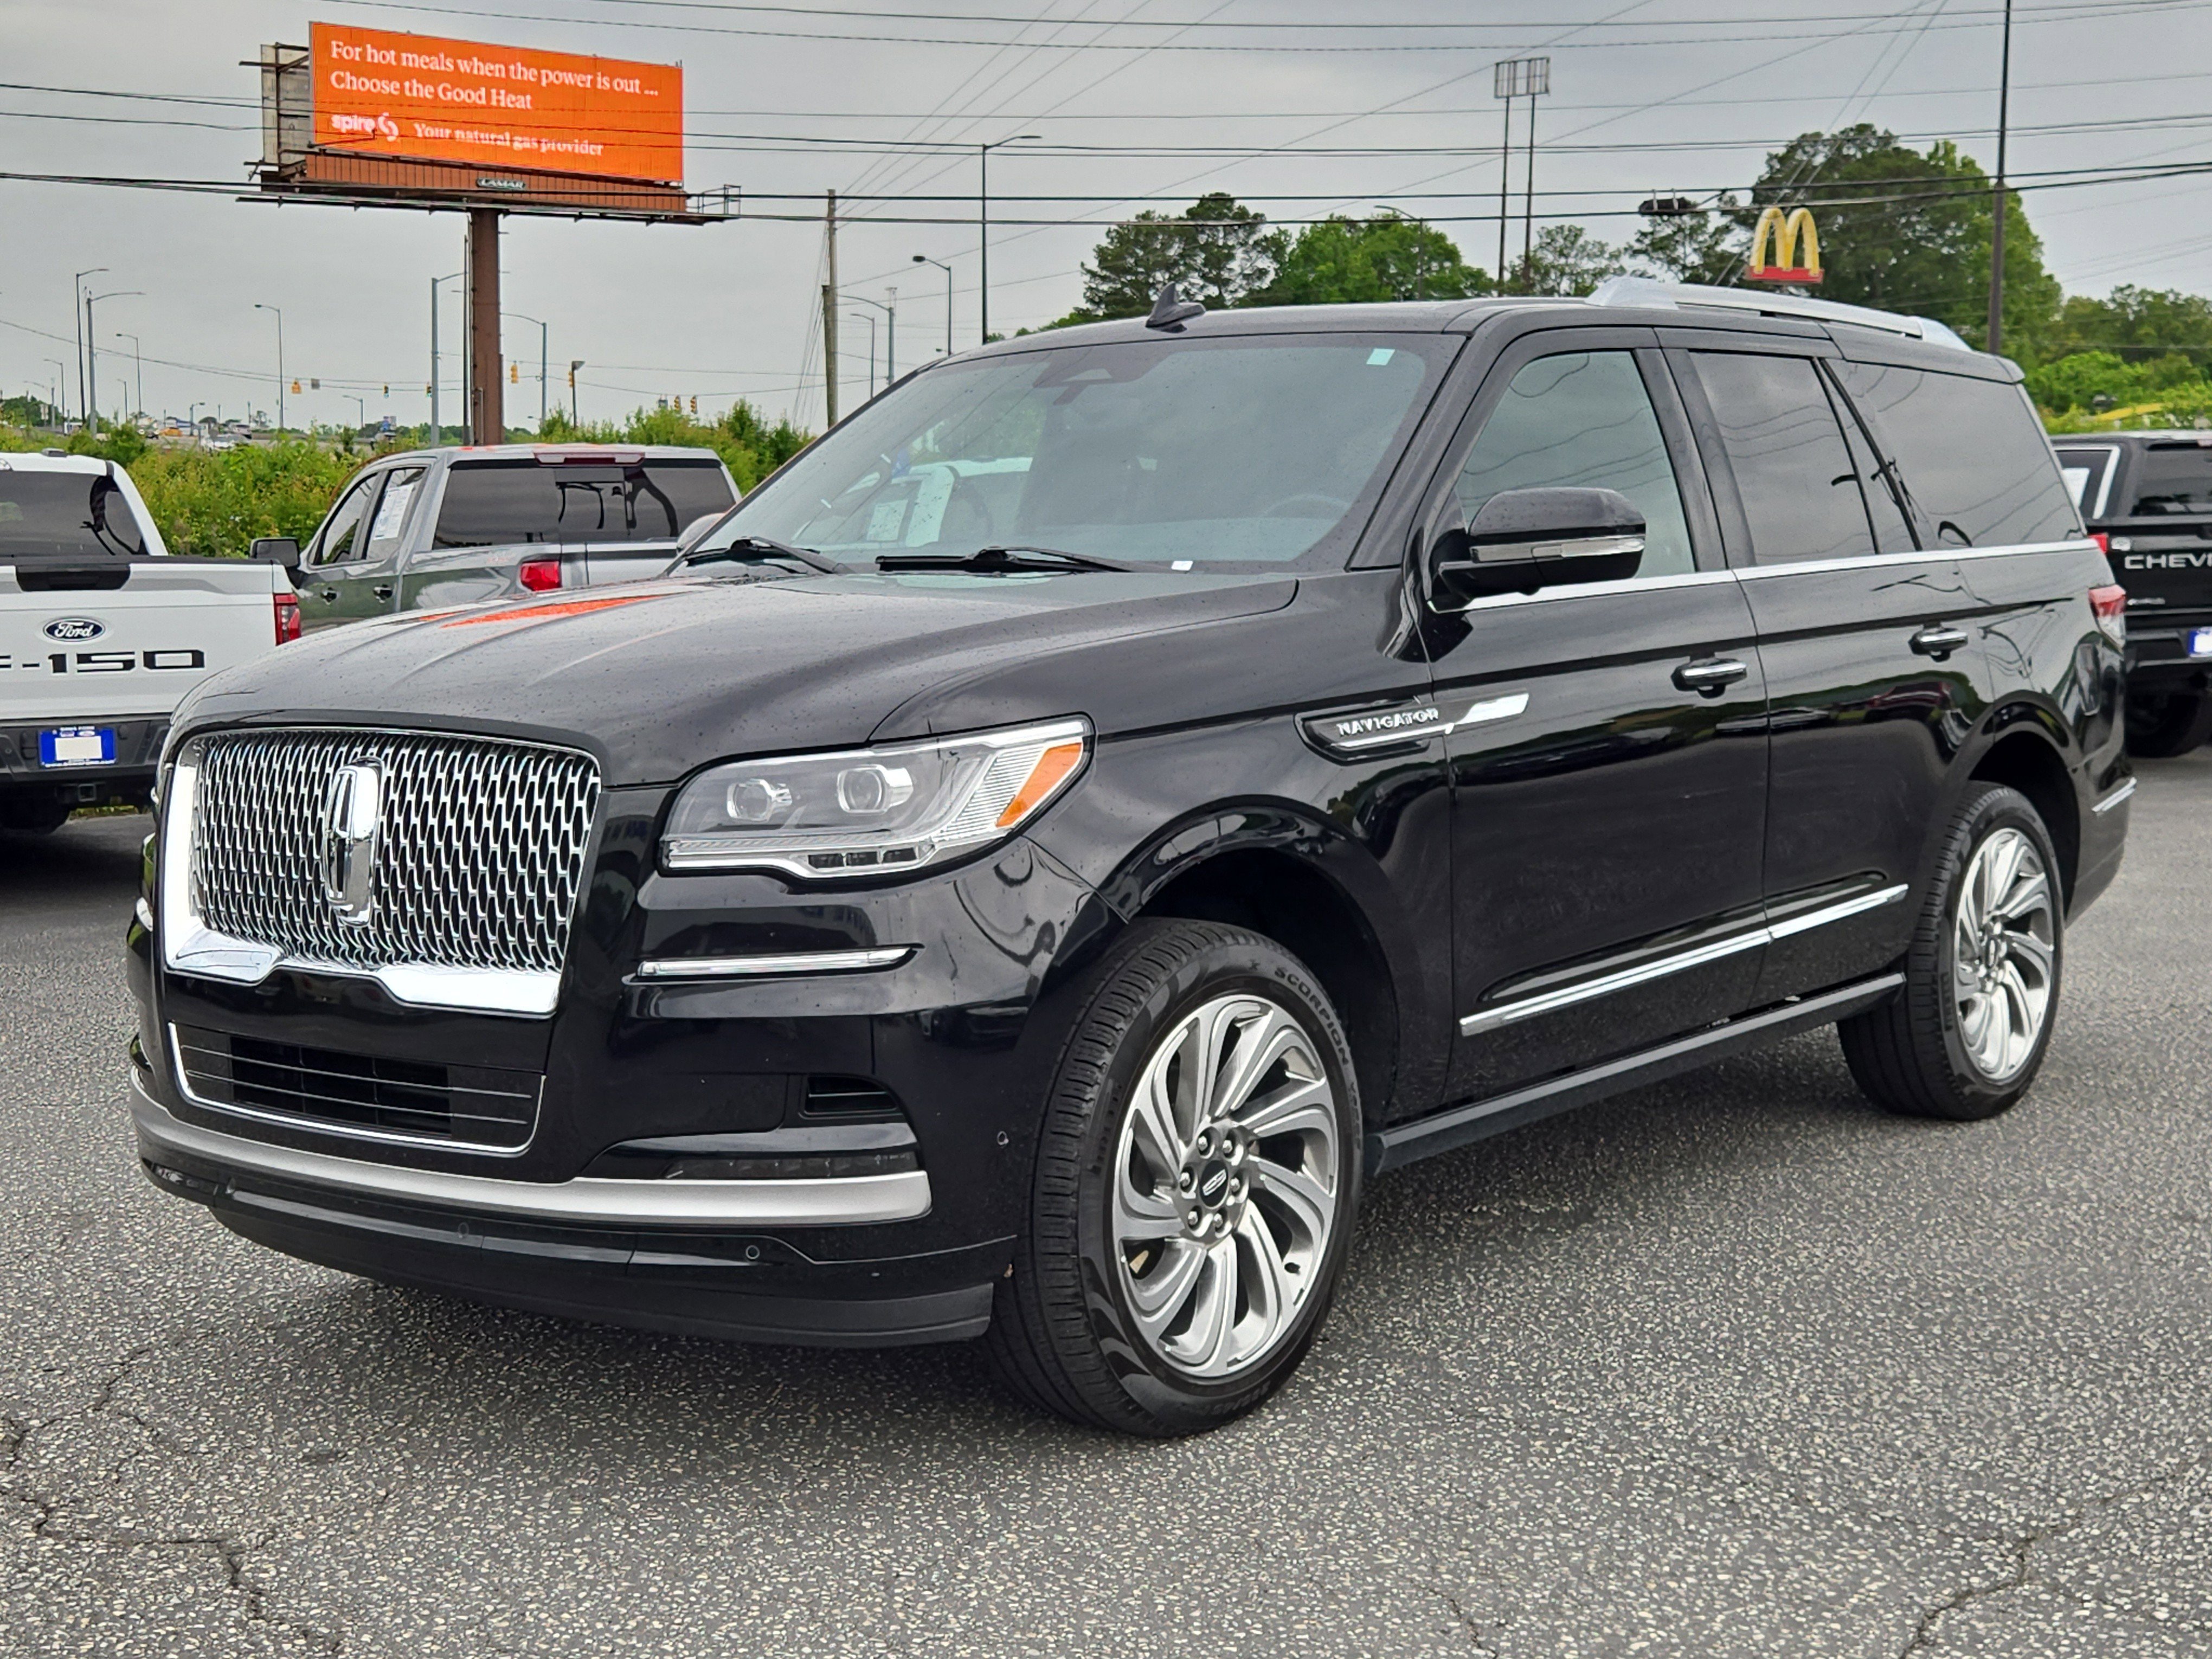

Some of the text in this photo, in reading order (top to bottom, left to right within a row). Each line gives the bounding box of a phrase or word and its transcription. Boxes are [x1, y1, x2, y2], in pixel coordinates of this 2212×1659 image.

[331, 40, 363, 61] For
[366, 44, 397, 66] hot
[401, 52, 454, 72] meals
[456, 57, 506, 79] when
[509, 62, 538, 82] the
[540, 68, 593, 88] power
[596, 72, 610, 90] is
[612, 77, 641, 94] out
[330, 70, 532, 110] Choose the Good Heat
[414, 122, 604, 156] Your natural gas provider
[2124, 552, 2212, 569] CHEV
[54, 621, 94, 638] Ford
[0, 649, 205, 674] -150
[1336, 708, 1439, 736] NAVIGATOR
[1274, 966, 1349, 1066] SCORPION
